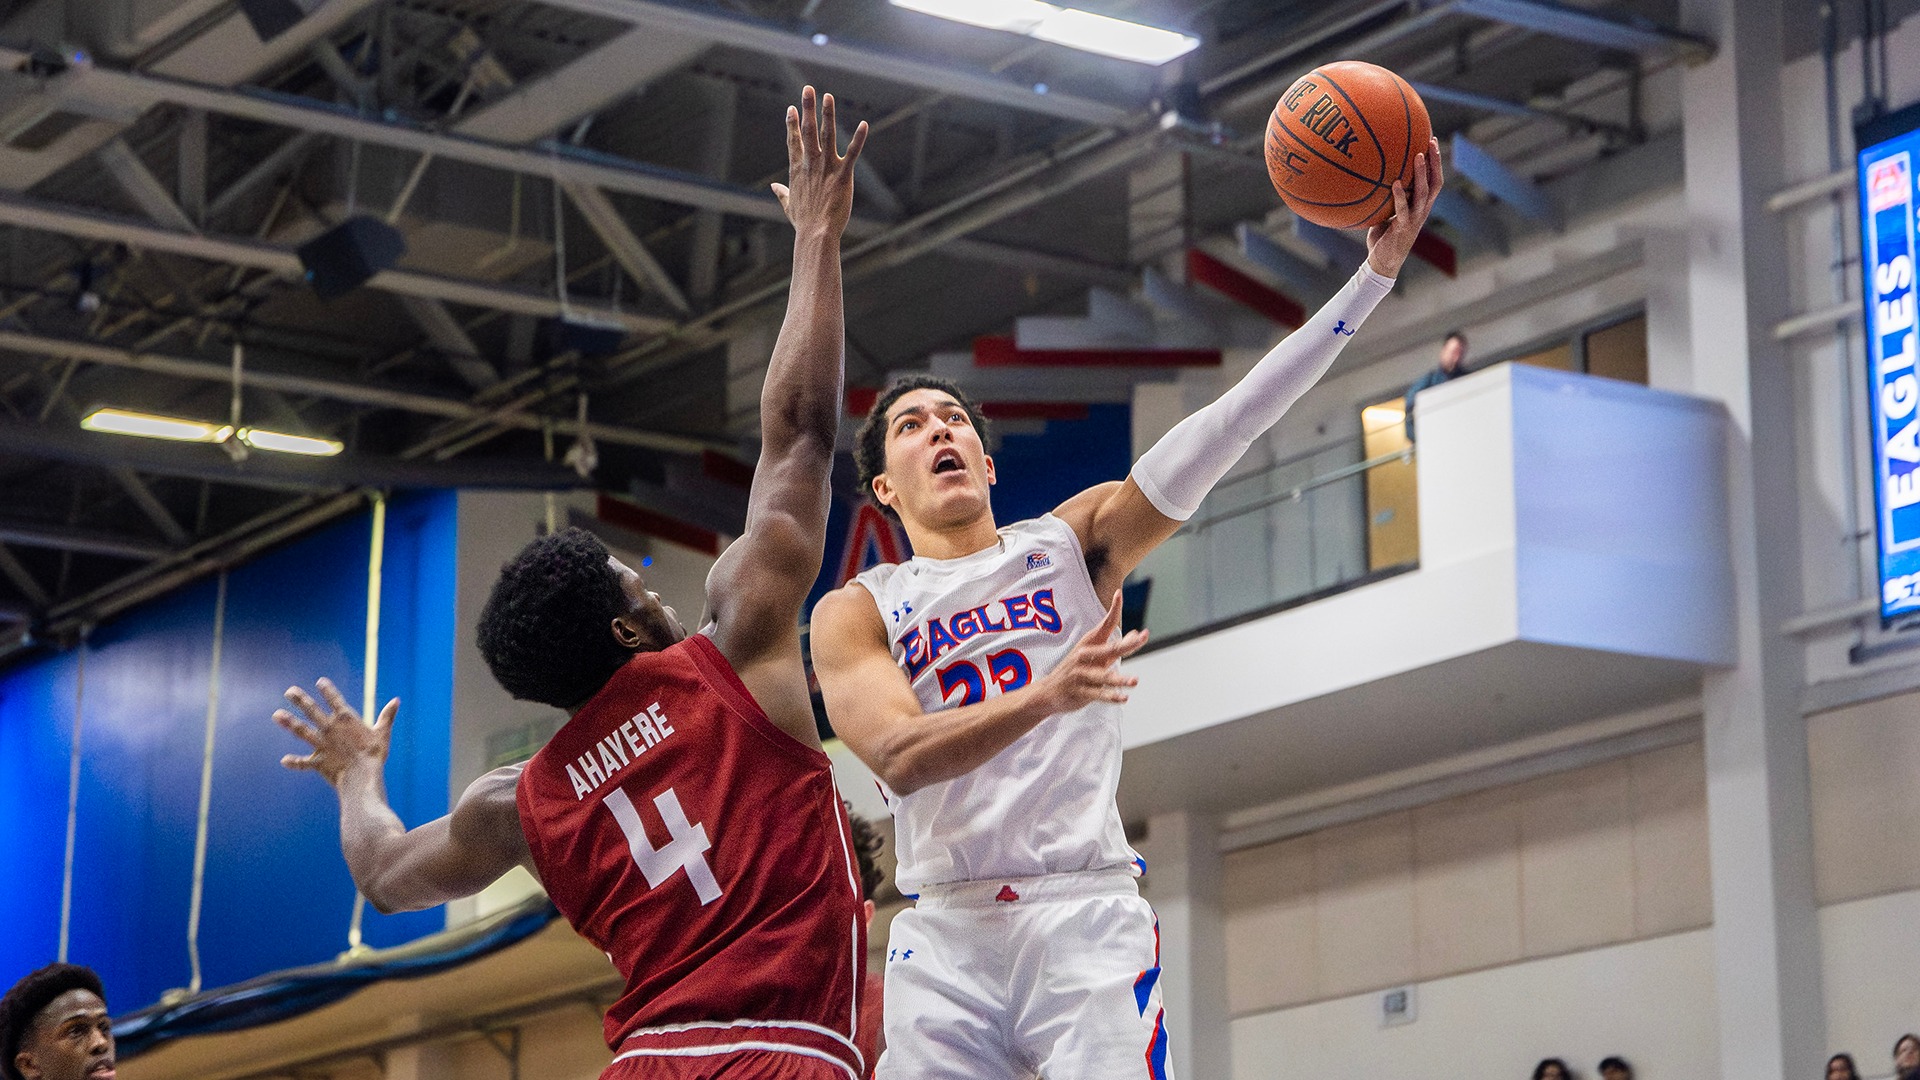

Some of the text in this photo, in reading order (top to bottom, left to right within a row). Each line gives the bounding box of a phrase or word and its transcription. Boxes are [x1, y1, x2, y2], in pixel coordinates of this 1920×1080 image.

[1300, 92, 1359, 159] ROCK
[1876, 254, 1920, 509] EAGLES
[895, 588, 1063, 684] EAGLES
[565, 702, 675, 800] AHAYERE
[602, 787, 723, 906] 4
